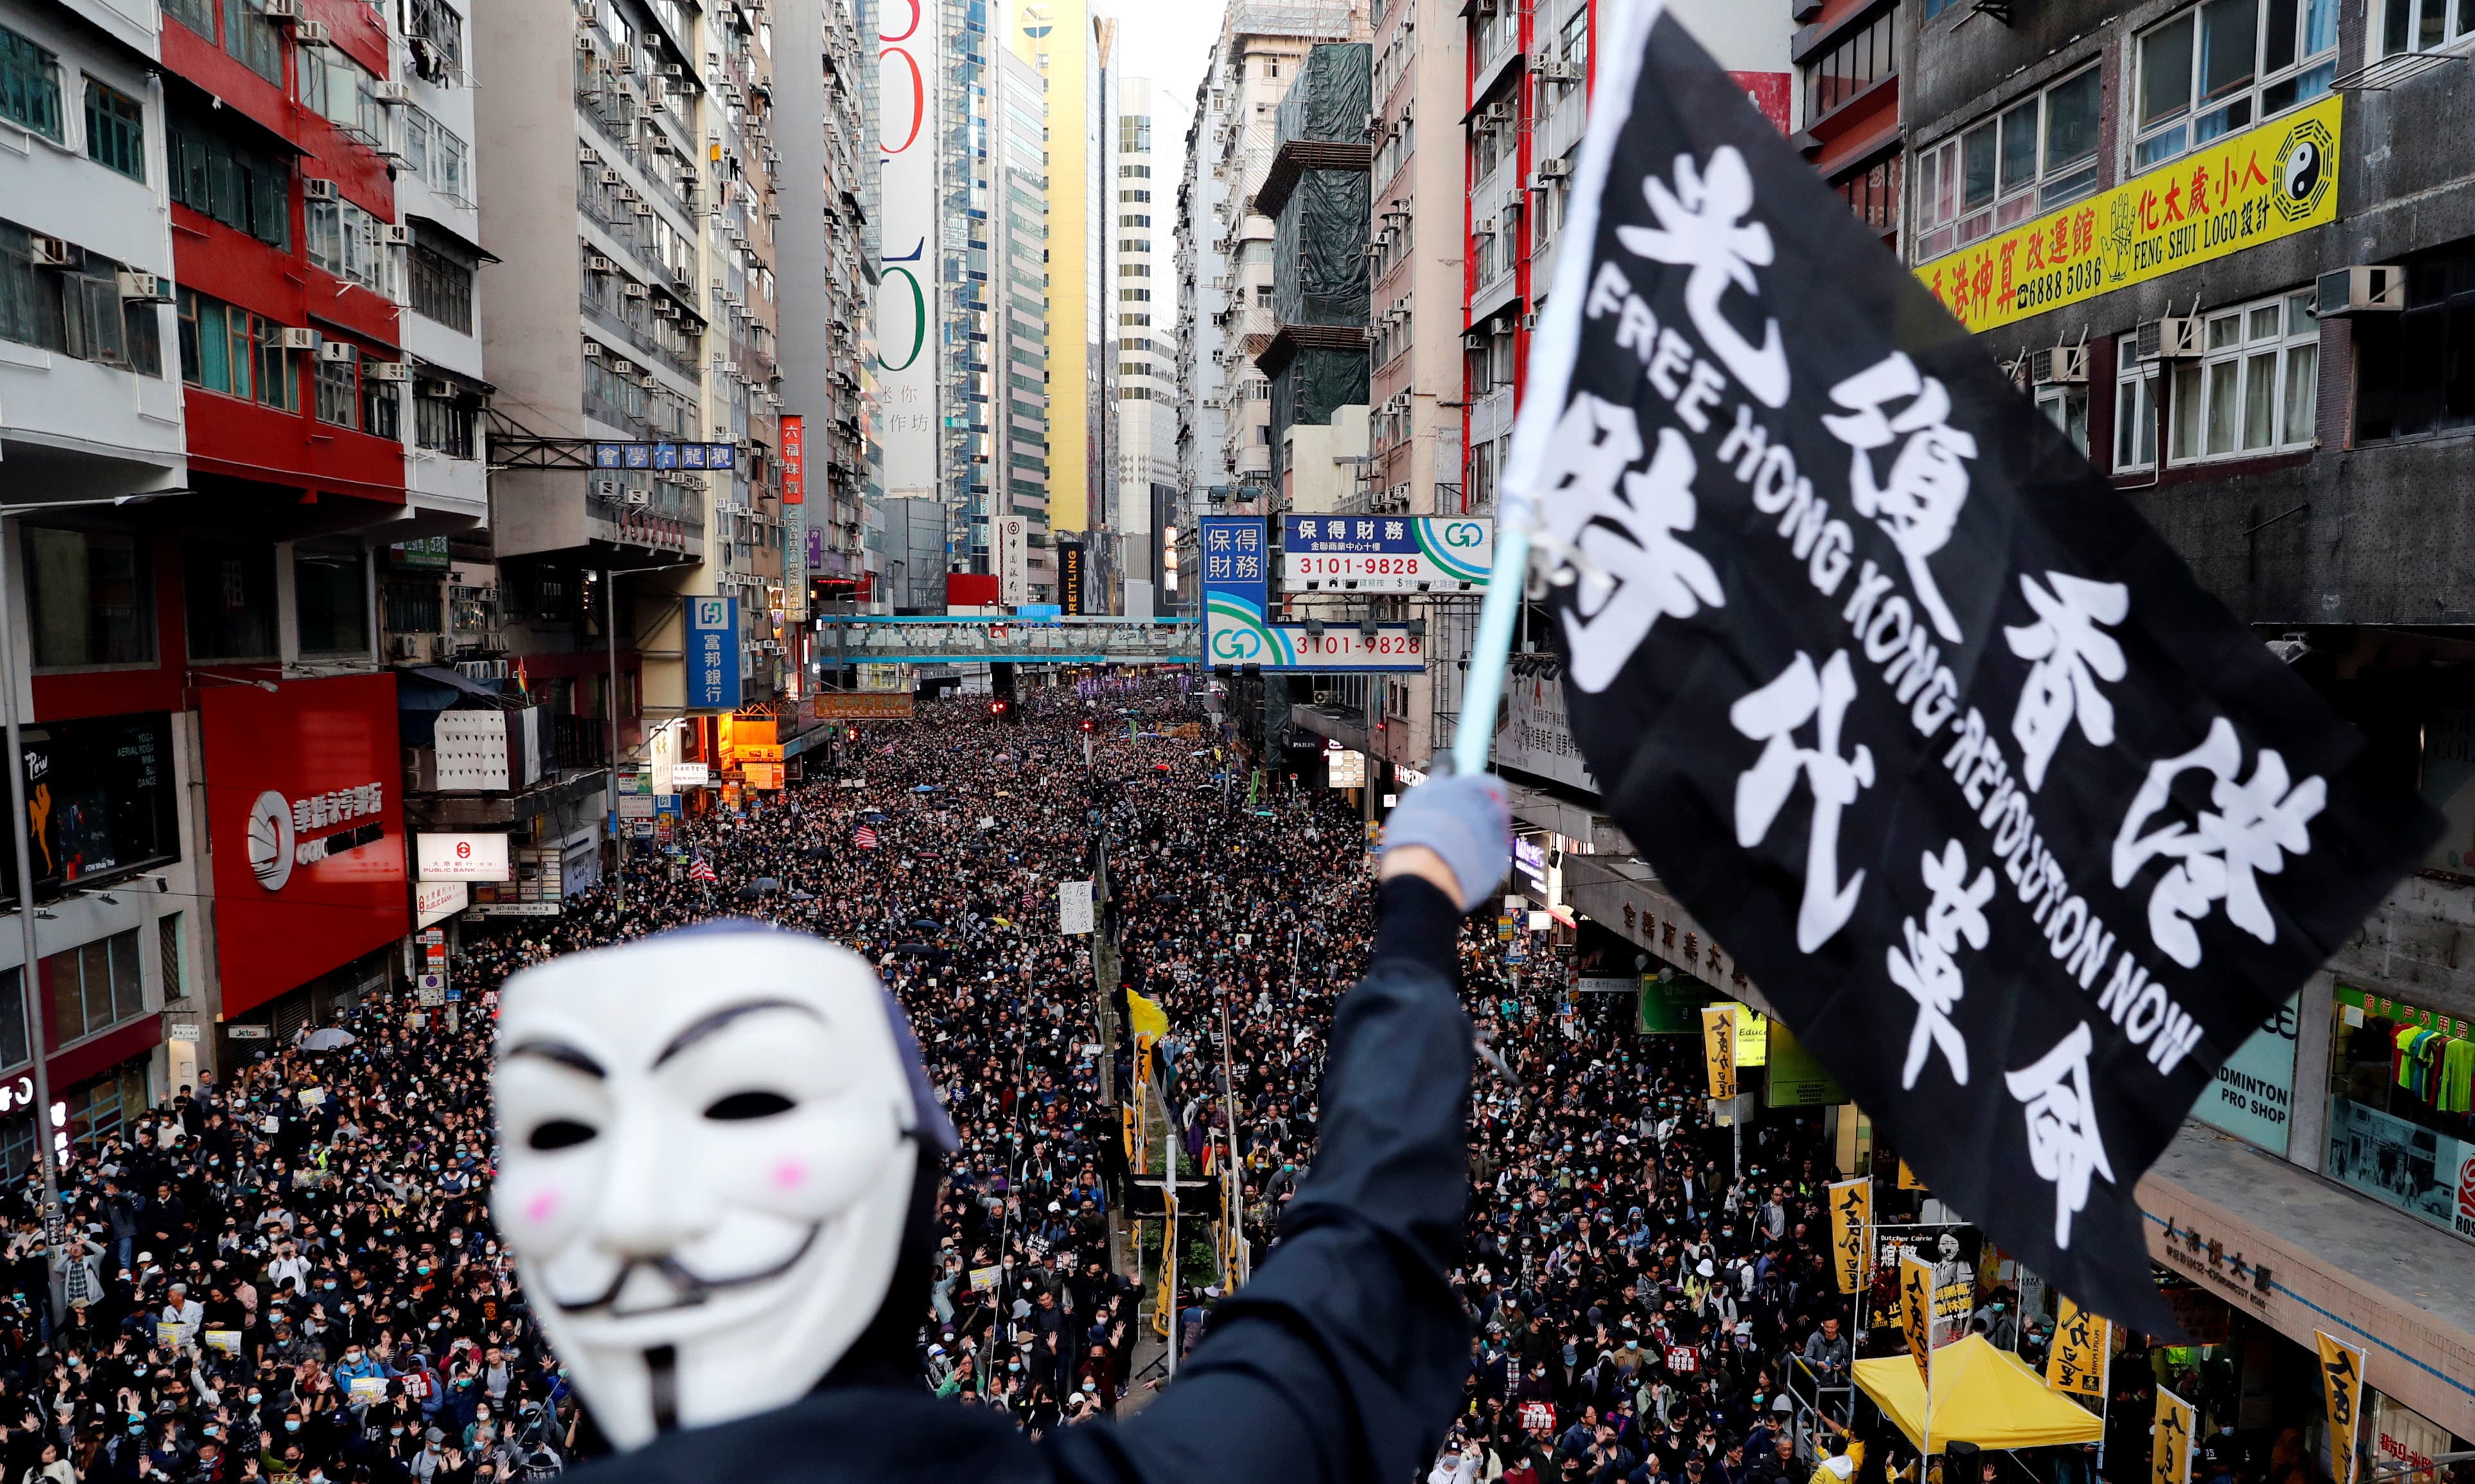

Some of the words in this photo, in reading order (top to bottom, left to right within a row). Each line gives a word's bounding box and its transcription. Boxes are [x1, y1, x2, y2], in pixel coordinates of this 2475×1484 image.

[2138, 149, 2269, 235] 化太歲小人
[2026, 208, 2095, 272] 改運館
[2134, 236, 2163, 272] FENG
[2168, 228, 2198, 259] SHUI
[2203, 209, 2237, 247] LOGO
[2241, 193, 2270, 237] 設計
[2029, 268, 2062, 308] 6888
[2066, 255, 2102, 295] 5036
[786, 424, 800, 495] 六福珠寶
[788, 507, 798, 554] LUKFOOK
[1208, 528, 1259, 553] 保得
[1298, 520, 1405, 540] 保得財務
[1310, 541, 1381, 552] 金聯商業中心十樓
[1208, 555, 1260, 579] 財務
[1299, 557, 1419, 575] 3101-9828
[1615, 144, 2328, 968] 光復香港
[788, 555, 800, 618] JEWELLERY
[1068, 549, 1077, 616] BREITLING
[1296, 636, 1420, 654] 3101-9828
[704, 634, 722, 703] 富邦銀行
[1586, 261, 1727, 434] FREE
[1716, 403, 1854, 597] HONG
[2097, 950, 2205, 1078] NOW
[118, 747, 138, 757] AERIAL
[139, 745, 154, 754] YOGA
[138, 733, 154, 743] YOGA
[142, 755, 155, 764] MMA
[138, 776, 157, 788] DANCE
[1543, 389, 2115, 1251] 時代革命
[426, 899, 441, 911] PUBLIC
[441, 895, 453, 905] BANK
[2221, 1088, 2247, 1109] PRO
[2251, 1100, 2286, 1125] SHOP
